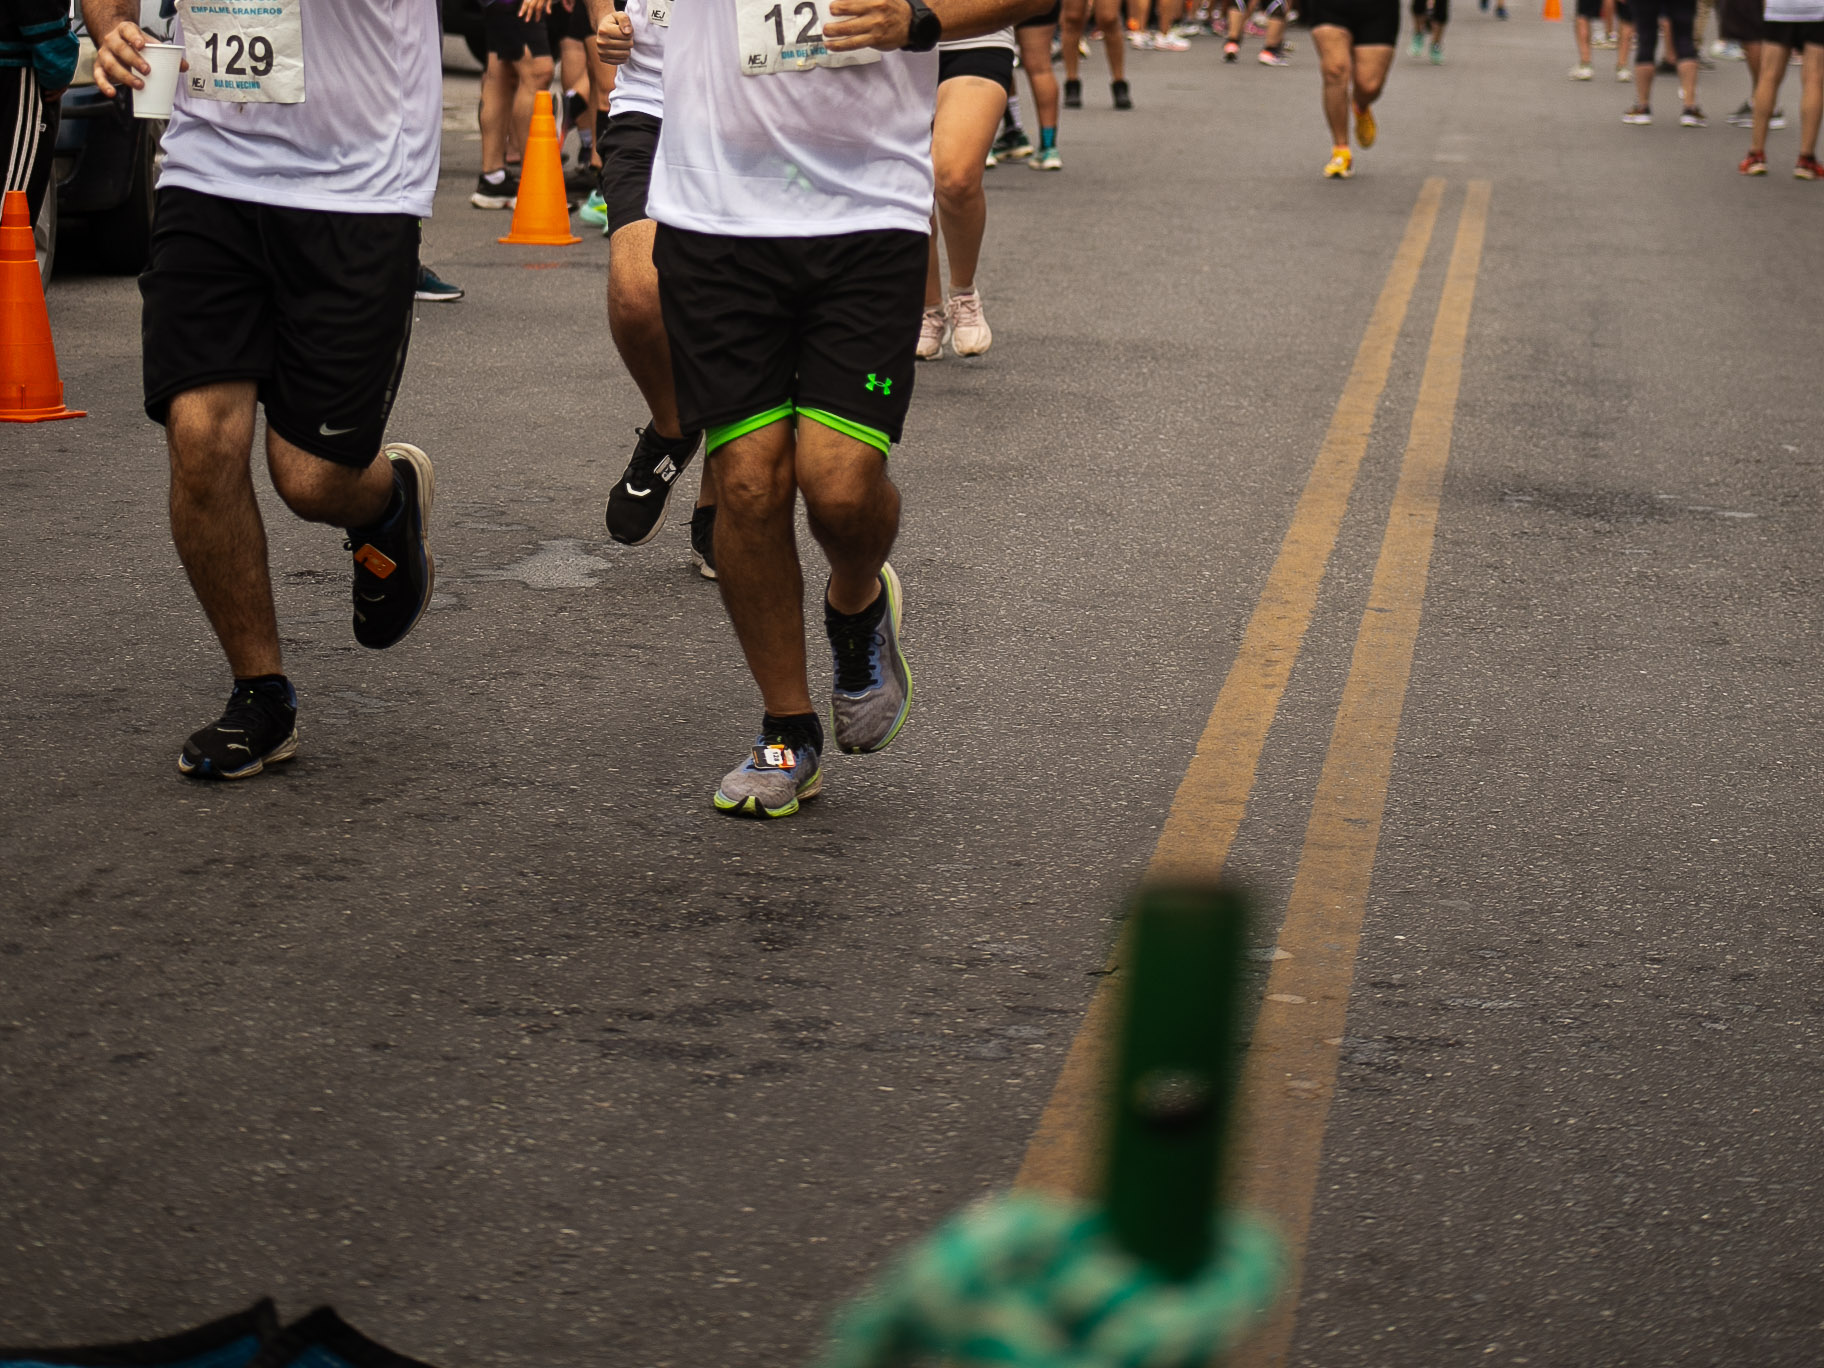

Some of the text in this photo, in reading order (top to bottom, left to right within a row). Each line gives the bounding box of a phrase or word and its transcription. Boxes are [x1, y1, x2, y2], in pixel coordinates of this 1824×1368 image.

[191, 5, 283, 15] EMPALME GRANEROS
[651, 9, 666, 19] NEJ
[764, 1, 823, 46] 12
[205, 32, 274, 77] 129
[748, 54, 768, 65] NEJ
[191, 77, 206, 89] NEJ
